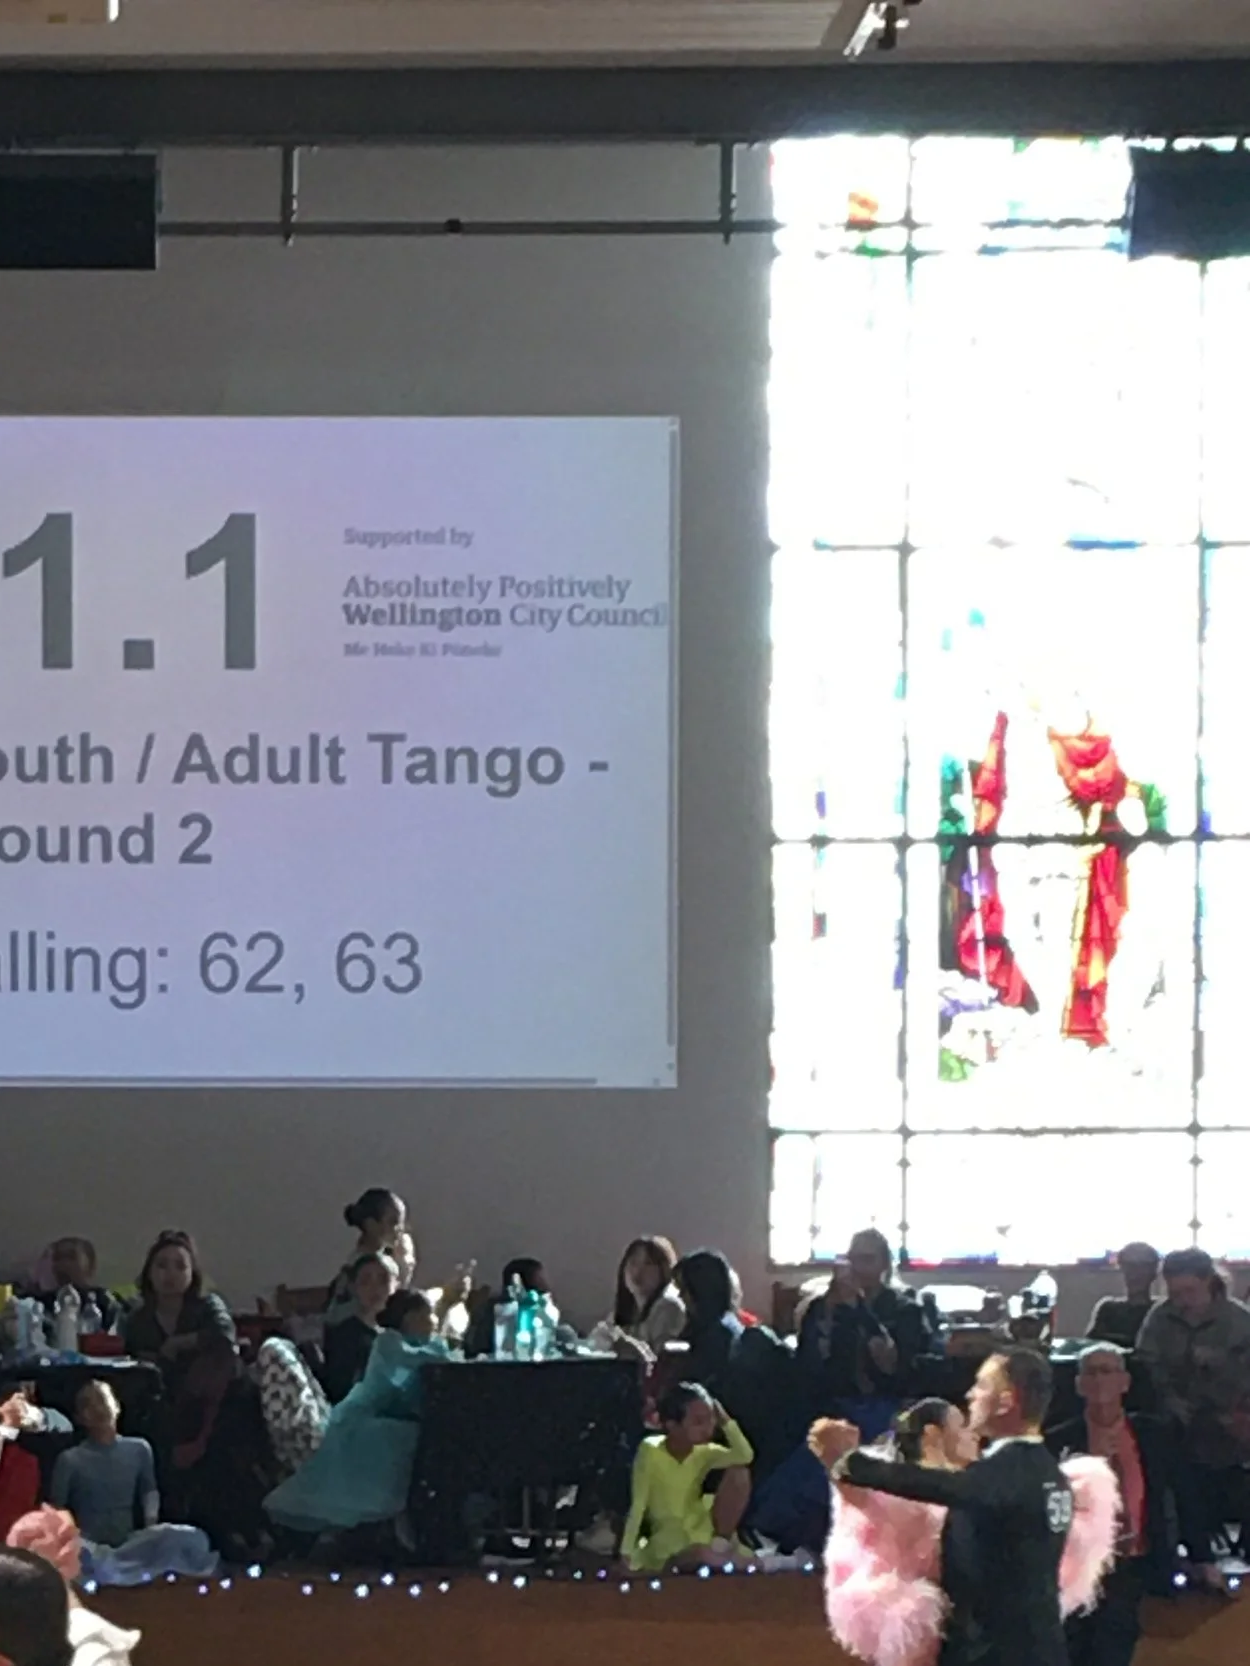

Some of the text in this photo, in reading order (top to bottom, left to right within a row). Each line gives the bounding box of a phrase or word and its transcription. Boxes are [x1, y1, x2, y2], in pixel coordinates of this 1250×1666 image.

[343, 527, 474, 549] Supported by
[343, 574, 631, 604] Absolutely Positively
[342, 603, 502, 633] Wellington
[509, 603, 562, 633] City
[136, 732, 155, 784] /
[171, 731, 347, 785] Adult
[366, 732, 565, 799] Tango
[178, 812, 213, 865] 2
[199, 931, 305, 1005] 62,
[335, 931, 423, 995] 63
